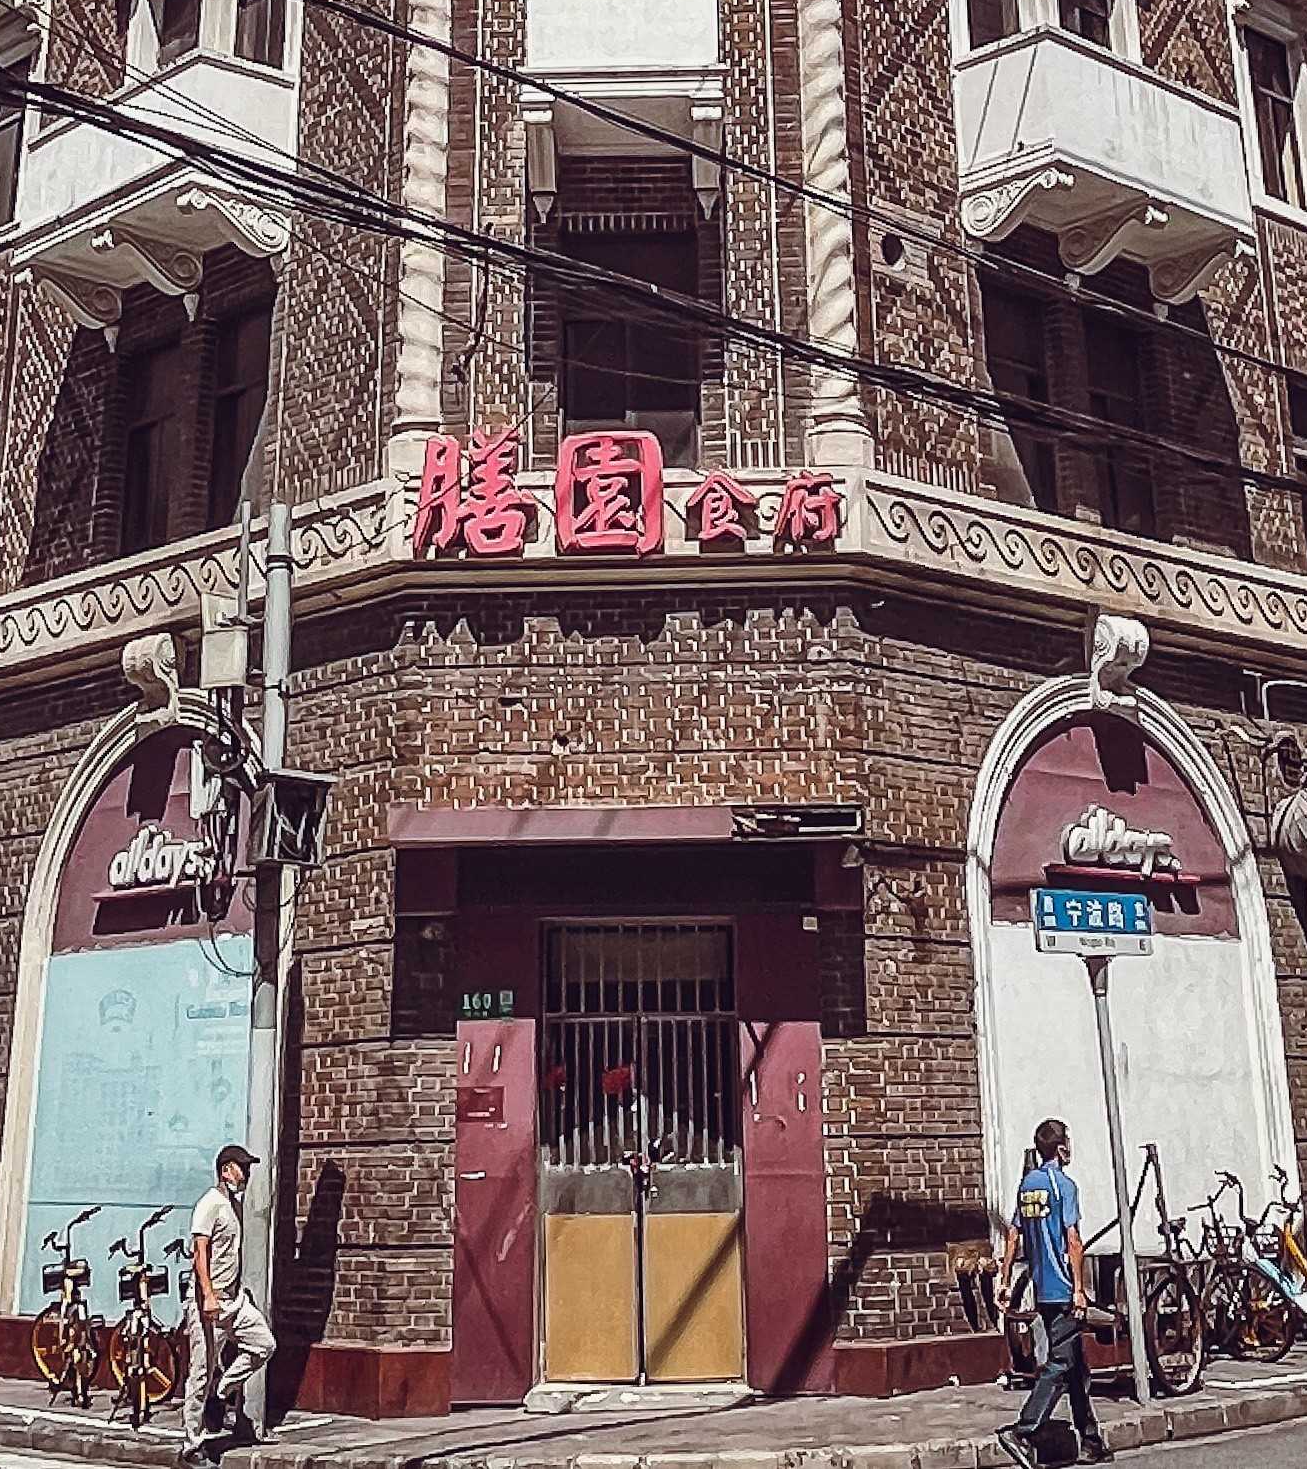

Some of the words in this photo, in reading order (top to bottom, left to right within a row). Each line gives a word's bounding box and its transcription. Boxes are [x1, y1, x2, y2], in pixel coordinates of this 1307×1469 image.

[414, 429, 843, 554] 膳園食府
[462, 992, 492, 1010] 160
